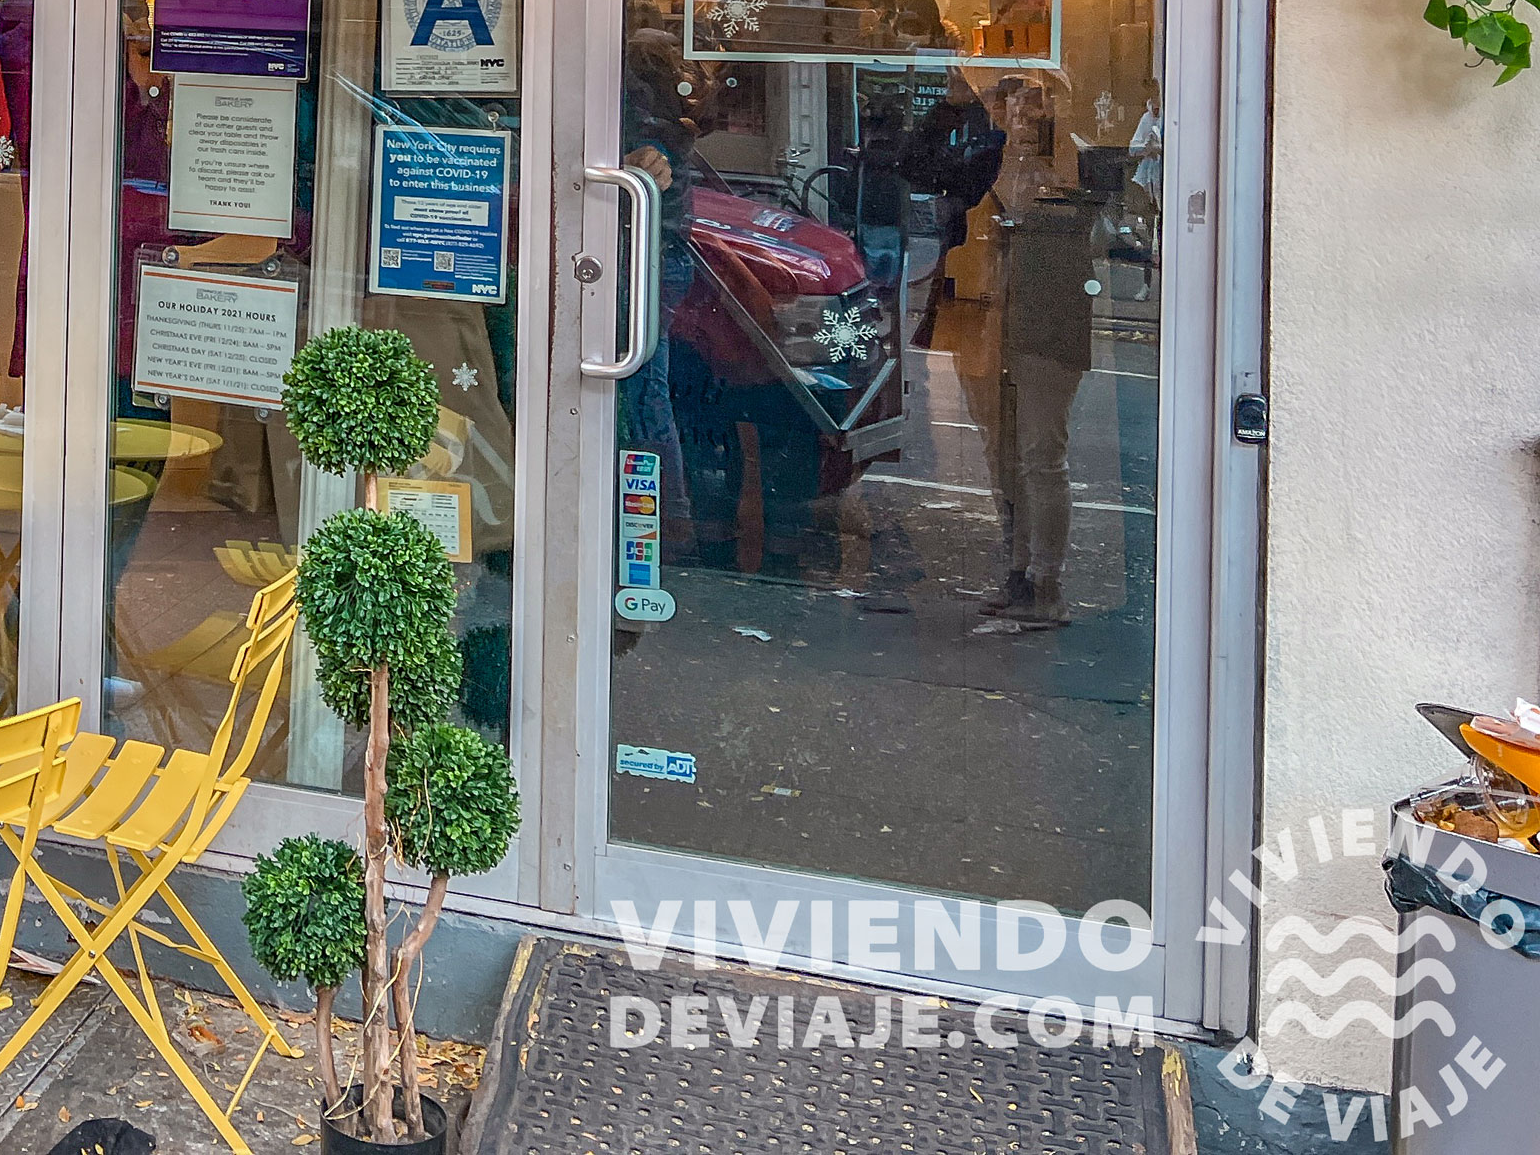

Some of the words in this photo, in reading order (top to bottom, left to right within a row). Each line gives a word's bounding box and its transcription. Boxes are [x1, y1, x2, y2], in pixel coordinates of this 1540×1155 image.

[480, 59, 505, 67] NYC
[196, 113, 219, 121] Please
[231, 116, 272, 124] considerate
[386, 139, 410, 149] New
[412, 140, 434, 150] York
[437, 143, 457, 154] City
[459, 144, 501, 155] requires
[389, 154, 411, 164] you
[413, 154, 424, 163] to
[426, 154, 440, 164] be
[441, 156, 497, 167] vaccinated
[397, 166, 434, 177] against
[436, 167, 489, 179] COVID-19
[389, 178, 401, 187] to
[402, 179, 429, 189] enter
[431, 178, 449, 189] this
[472, 284, 498, 295] NYC
[158, 301, 177, 310] OUR
[180, 303, 219, 316] HOLIDAY
[222, 309, 242, 318] 2021
[246, 311, 276, 322] HOURS
[147, 315, 196, 327] THANKSGIVING
[249, 328, 264, 336] 7AM
[273, 331, 287, 339] 1PM
[150, 329, 188, 340] CHRISTMAS
[190, 334, 202, 342] EVE
[152, 343, 189, 355] CHRISTMAS
[191, 348, 206, 356] DAY
[249, 355, 278, 366] CLOSED
[148, 356, 163, 364] NEW
[165, 357, 188, 367] YEAR'S
[189, 362, 202, 370] EVE
[165, 372, 188, 381] YEAR'S
[190, 375, 204, 384] DAY
[251, 383, 279, 394] CLOSED
[626, 478, 657, 491] VISA
[625, 521, 654, 529] DISCOVER
[624, 597, 638, 611] G
[641, 598, 666, 615] Pay
[620, 759, 654, 769] secured
[654, 763, 665, 772] by
[667, 759, 693, 775] ADT
